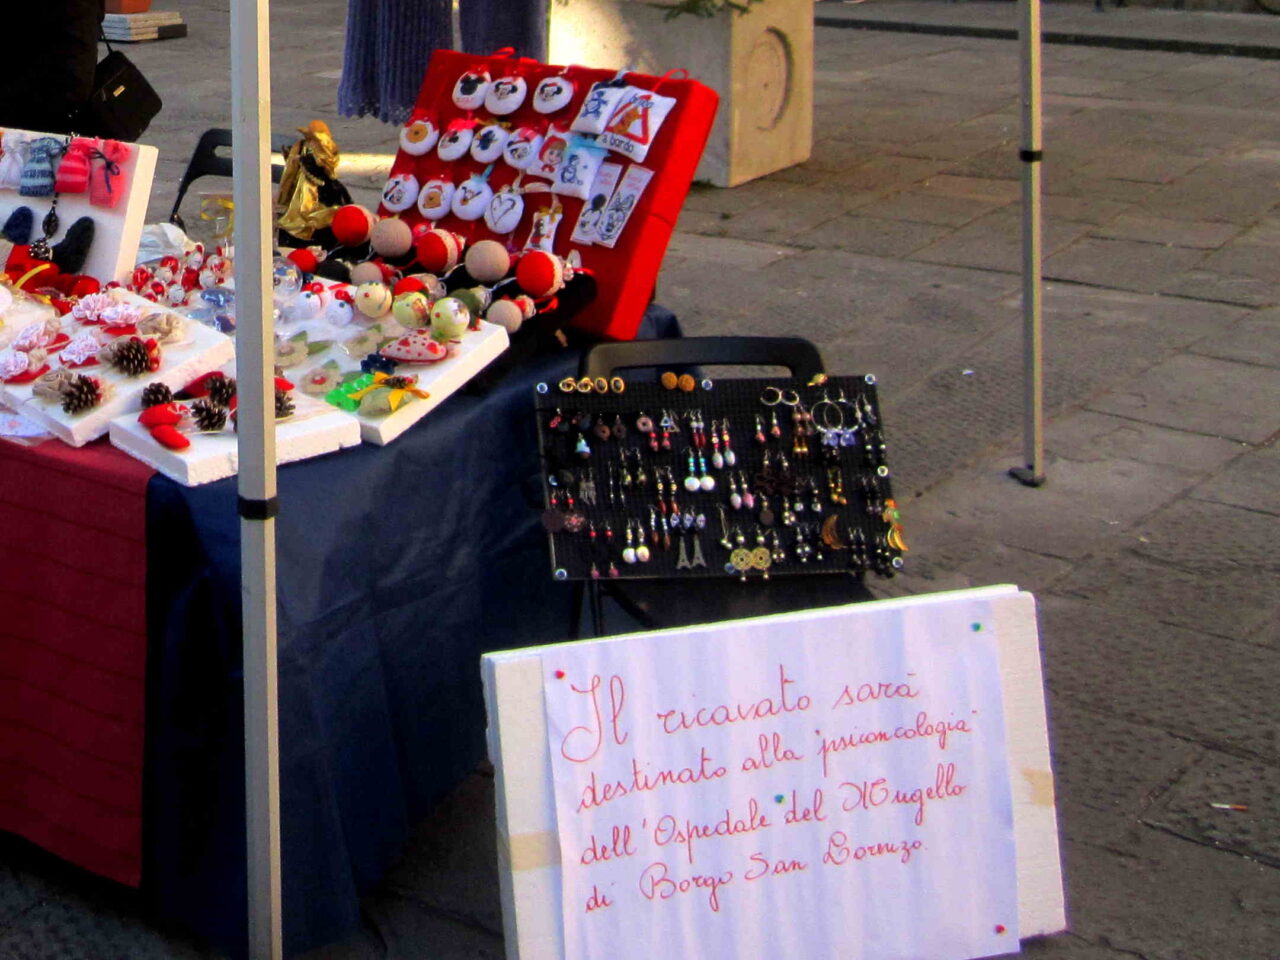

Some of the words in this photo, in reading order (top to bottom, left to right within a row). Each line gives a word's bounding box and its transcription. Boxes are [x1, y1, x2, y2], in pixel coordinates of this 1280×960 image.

[610, 133, 635, 153] bordo
[561, 674, 628, 763] Il
[656, 663, 811, 735] ricavato
[831, 672, 921, 710] sarà
[576, 746, 728, 814] destinato
[741, 731, 804, 769] alla
[784, 788, 828, 825] del
[837, 762, 968, 827] Mugello
[585, 882, 614, 913] di
[639, 861, 734, 913] Borgo
[743, 851, 808, 881] San
